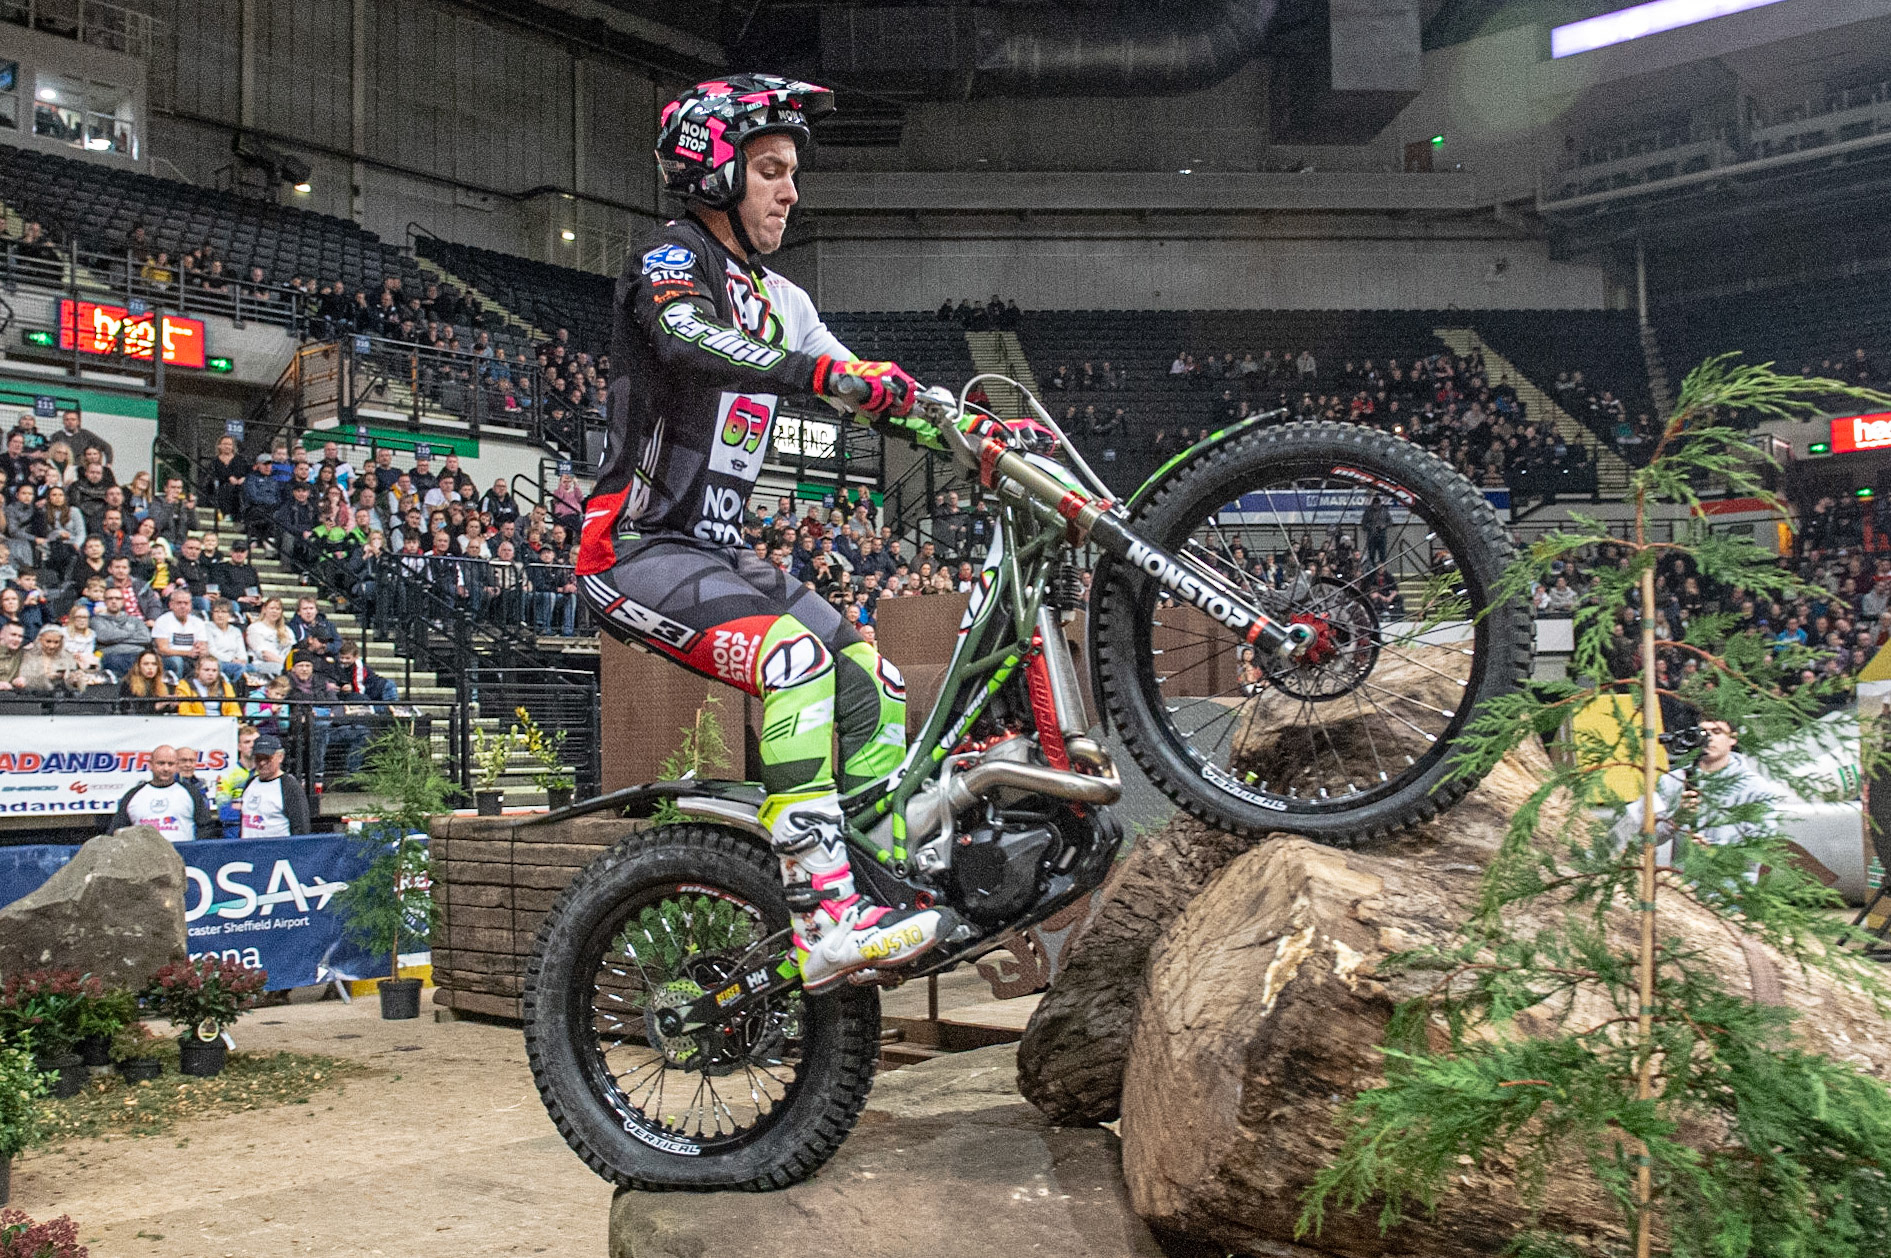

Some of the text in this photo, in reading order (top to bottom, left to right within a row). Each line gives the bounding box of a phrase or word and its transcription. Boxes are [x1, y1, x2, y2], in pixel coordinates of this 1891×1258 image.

[678, 135, 707, 153] STOP
[682, 120, 710, 142] NON
[702, 484, 746, 523] NO
[1126, 540, 1250, 628] NONSTOP
[712, 630, 733, 679] NON
[728, 631, 749, 682] STOP
[223, 918, 272, 934] Sheffield
[273, 916, 310, 930] Airport
[859, 924, 923, 960] BUSTO
[625, 1119, 700, 1154] VERTICAL
